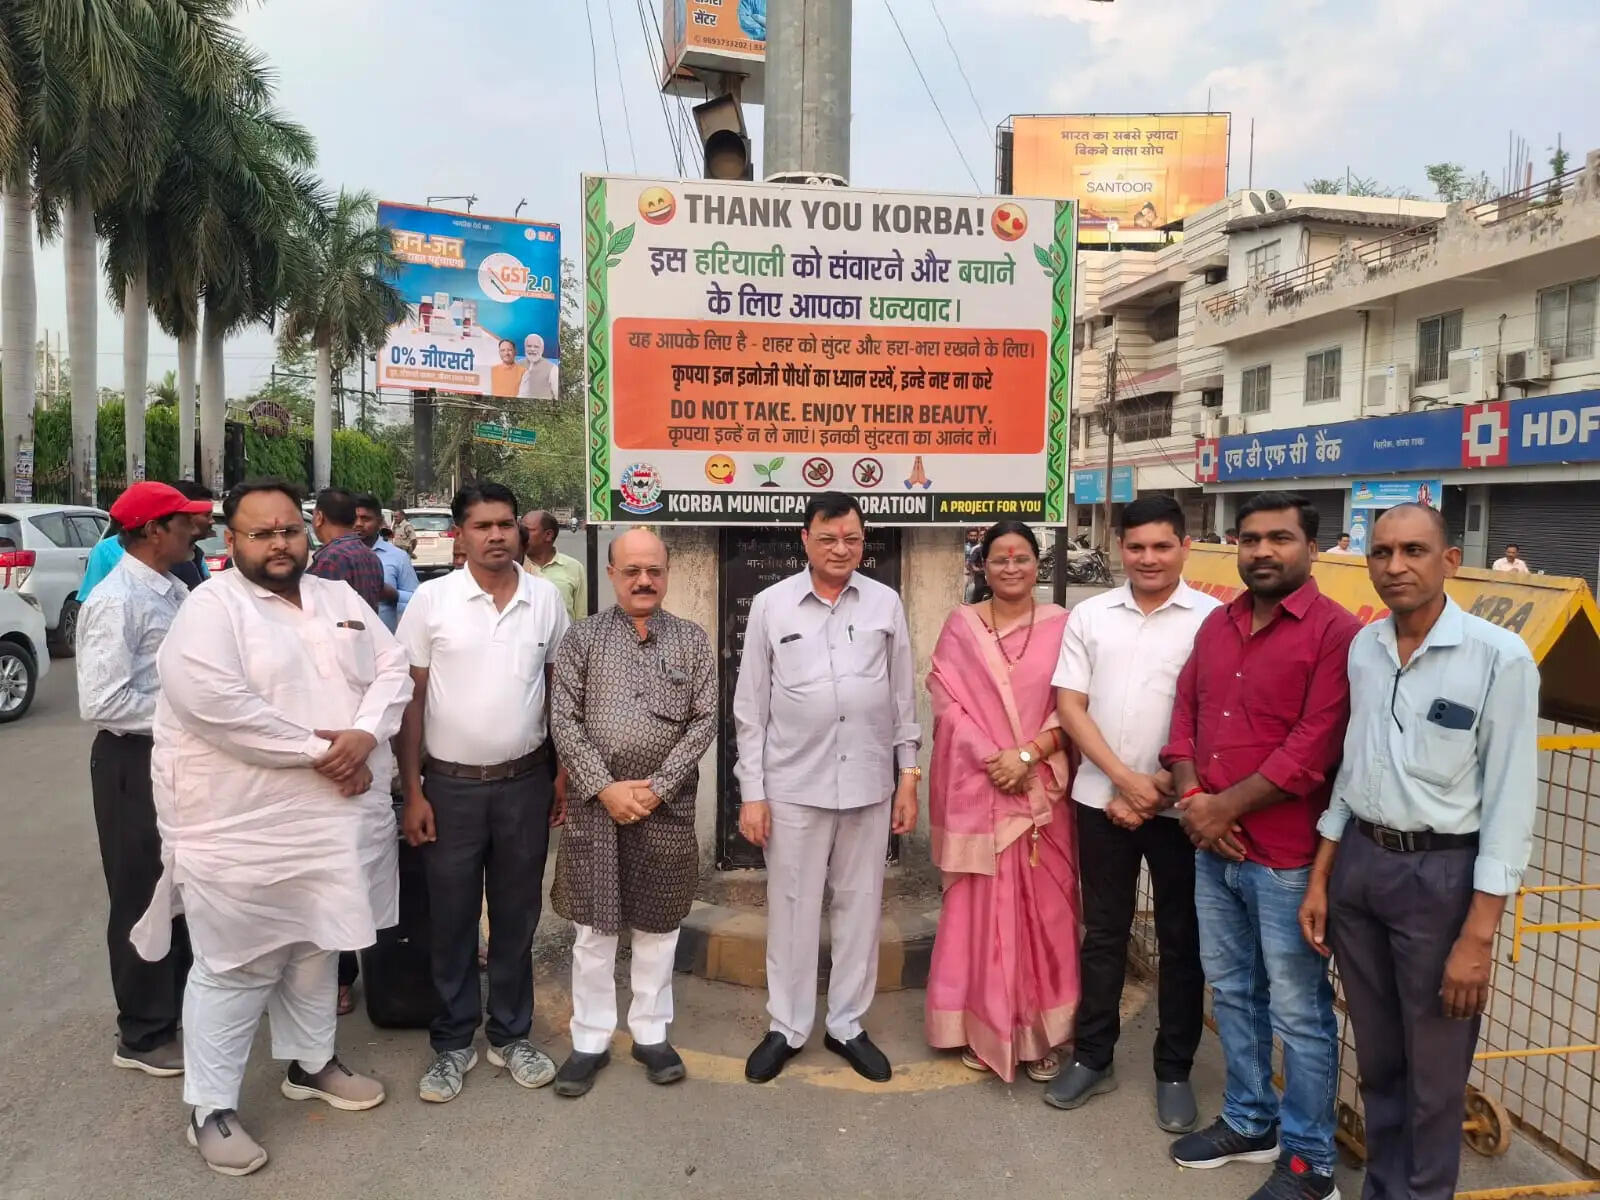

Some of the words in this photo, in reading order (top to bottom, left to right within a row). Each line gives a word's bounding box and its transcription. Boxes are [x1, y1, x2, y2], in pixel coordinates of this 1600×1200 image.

[694, 9, 717, 26] सेंटर
[1061, 130, 1089, 141] भारत
[1092, 131, 1109, 141] का
[1113, 128, 1141, 140] सबसे
[1146, 130, 1178, 142] ज़्यादा
[1075, 143, 1108, 156] बिकने
[1112, 146, 1137, 156] वाला
[1141, 143, 1164, 156] सोप
[1086, 181, 1153, 193] SANTOOR
[684, 194, 792, 228] THANK
[801, 200, 861, 231] YOU
[872, 203, 984, 236] KORBA!
[648, 247, 687, 276] इस
[693, 241, 785, 277] हरियाली
[791, 245, 822, 279] को
[828, 248, 904, 281] संवारने
[911, 248, 951, 283] और
[957, 252, 1016, 286] बचाने
[501, 266, 529, 285] GST
[528, 275, 552, 292] 2.0
[706, 281, 732, 315] के
[738, 283, 783, 317] लिए
[790, 293, 862, 320] आपका
[869, 296, 961, 322] धन्यवाद।
[628, 332, 652, 348] यह
[656, 328, 700, 349] आपके
[704, 330, 732, 350] लिए
[736, 330, 748, 351] है
[762, 336, 793, 352] शहर
[797, 333, 817, 353] को
[821, 335, 851, 359] सुंदर
[856, 334, 882, 355] और
[886, 340, 940, 356] हरा-भरा
[944, 337, 980, 357] रखने
[984, 337, 999, 356] के
[1003, 338, 1034, 358] लिए।
[391, 346, 416, 365] 0%
[419, 344, 475, 371] जीएसटी
[671, 364, 710, 391] कृपया
[712, 366, 734, 386] इन
[737, 362, 779, 387] इनोजी
[782, 363, 812, 387] पौधों
[813, 369, 830, 387] का
[833, 369, 866, 388] ध्यान
[869, 366, 897, 392] रखें,
[900, 366, 926, 390] इन्हे
[953, 371, 969, 389] ना
[972, 367, 993, 390] करे
[671, 400, 696, 419] DO
[702, 401, 739, 420] NOT
[744, 401, 796, 421] TAKE.
[802, 402, 856, 426] ENJOY
[861, 404, 913, 424] THEIR
[919, 405, 992, 424] BEAUTY.
[1521, 405, 1600, 448] HDF
[667, 426, 710, 447] कृपया
[713, 422, 744, 445] इन्हें
[746, 428, 761, 443] न
[763, 424, 779, 443] ले
[782, 426, 815, 444] जाएं।
[819, 425, 860, 446] इनकी
[864, 427, 908, 450] सुंदरता
[913, 430, 933, 445] का
[936, 428, 974, 446] आनंद
[977, 426, 996, 445] लें।
[1225, 449, 1244, 474] एच
[1246, 439, 1262, 467] डी
[1264, 445, 1286, 471] एफ
[1289, 433, 1308, 464] सी
[1315, 428, 1343, 462] बैंक
[668, 494, 723, 513] KORBA
[728, 495, 811, 514] MUNICIPA
[853, 495, 926, 514] ORATION
[940, 501, 948, 512] A
[950, 501, 993, 515] PROJECT
[996, 501, 1017, 513] FOR
[1020, 501, 1041, 513] YOU
